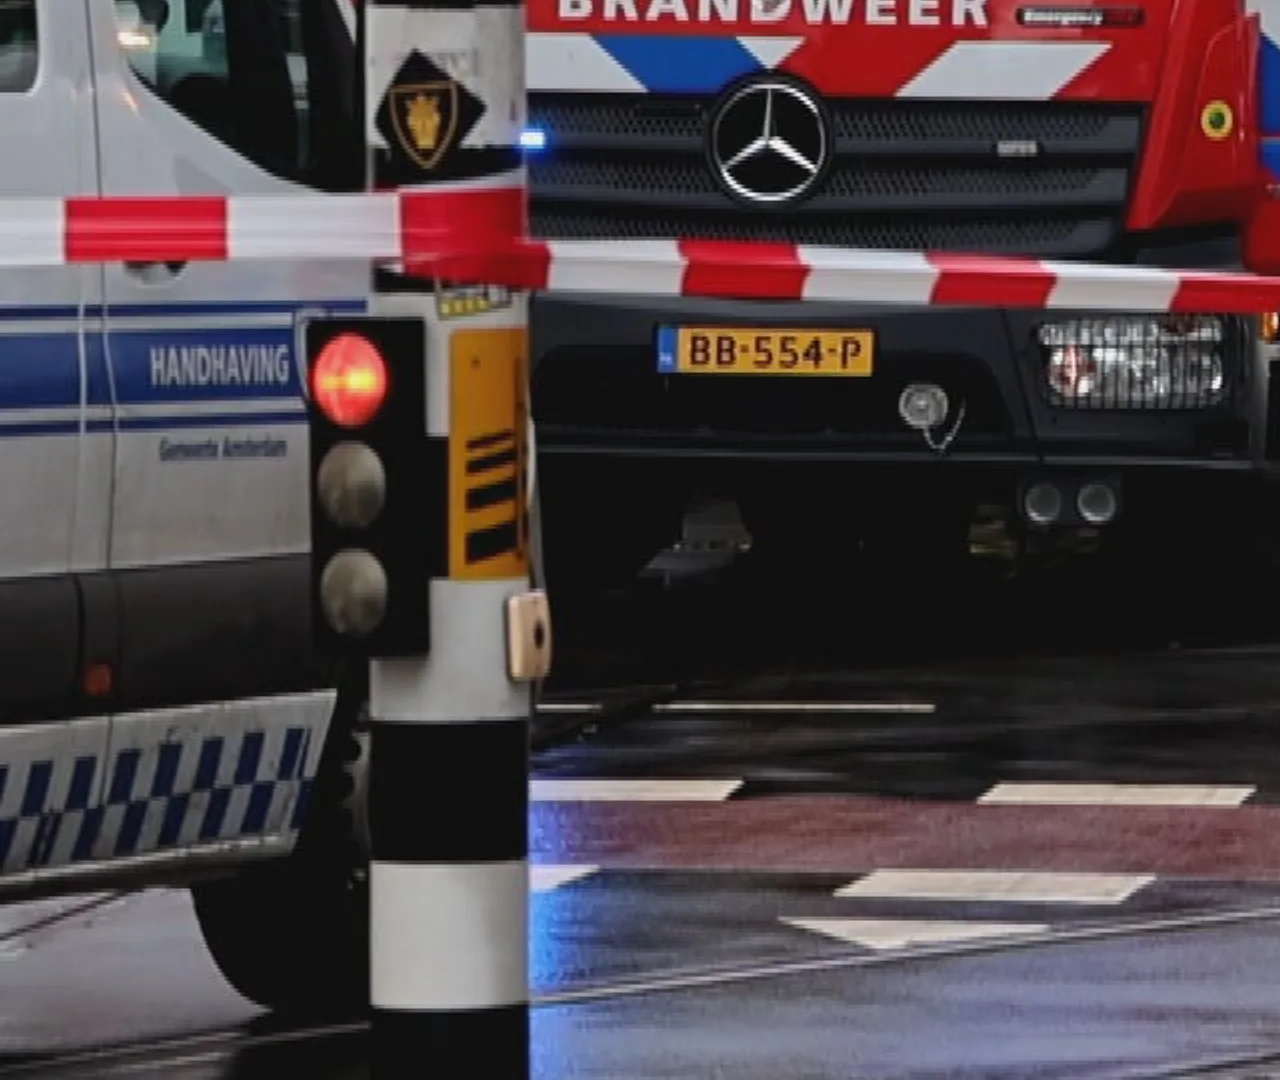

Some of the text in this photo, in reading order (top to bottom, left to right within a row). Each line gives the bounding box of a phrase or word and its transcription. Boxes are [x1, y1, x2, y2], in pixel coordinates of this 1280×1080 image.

[1022, 8, 1103, 26] Emergency
[151, 344, 289, 386] HANDHAVING
[690, 336, 861, 369] BB-554-P
[159, 434, 287, 462] Gemeente Amsterdam
